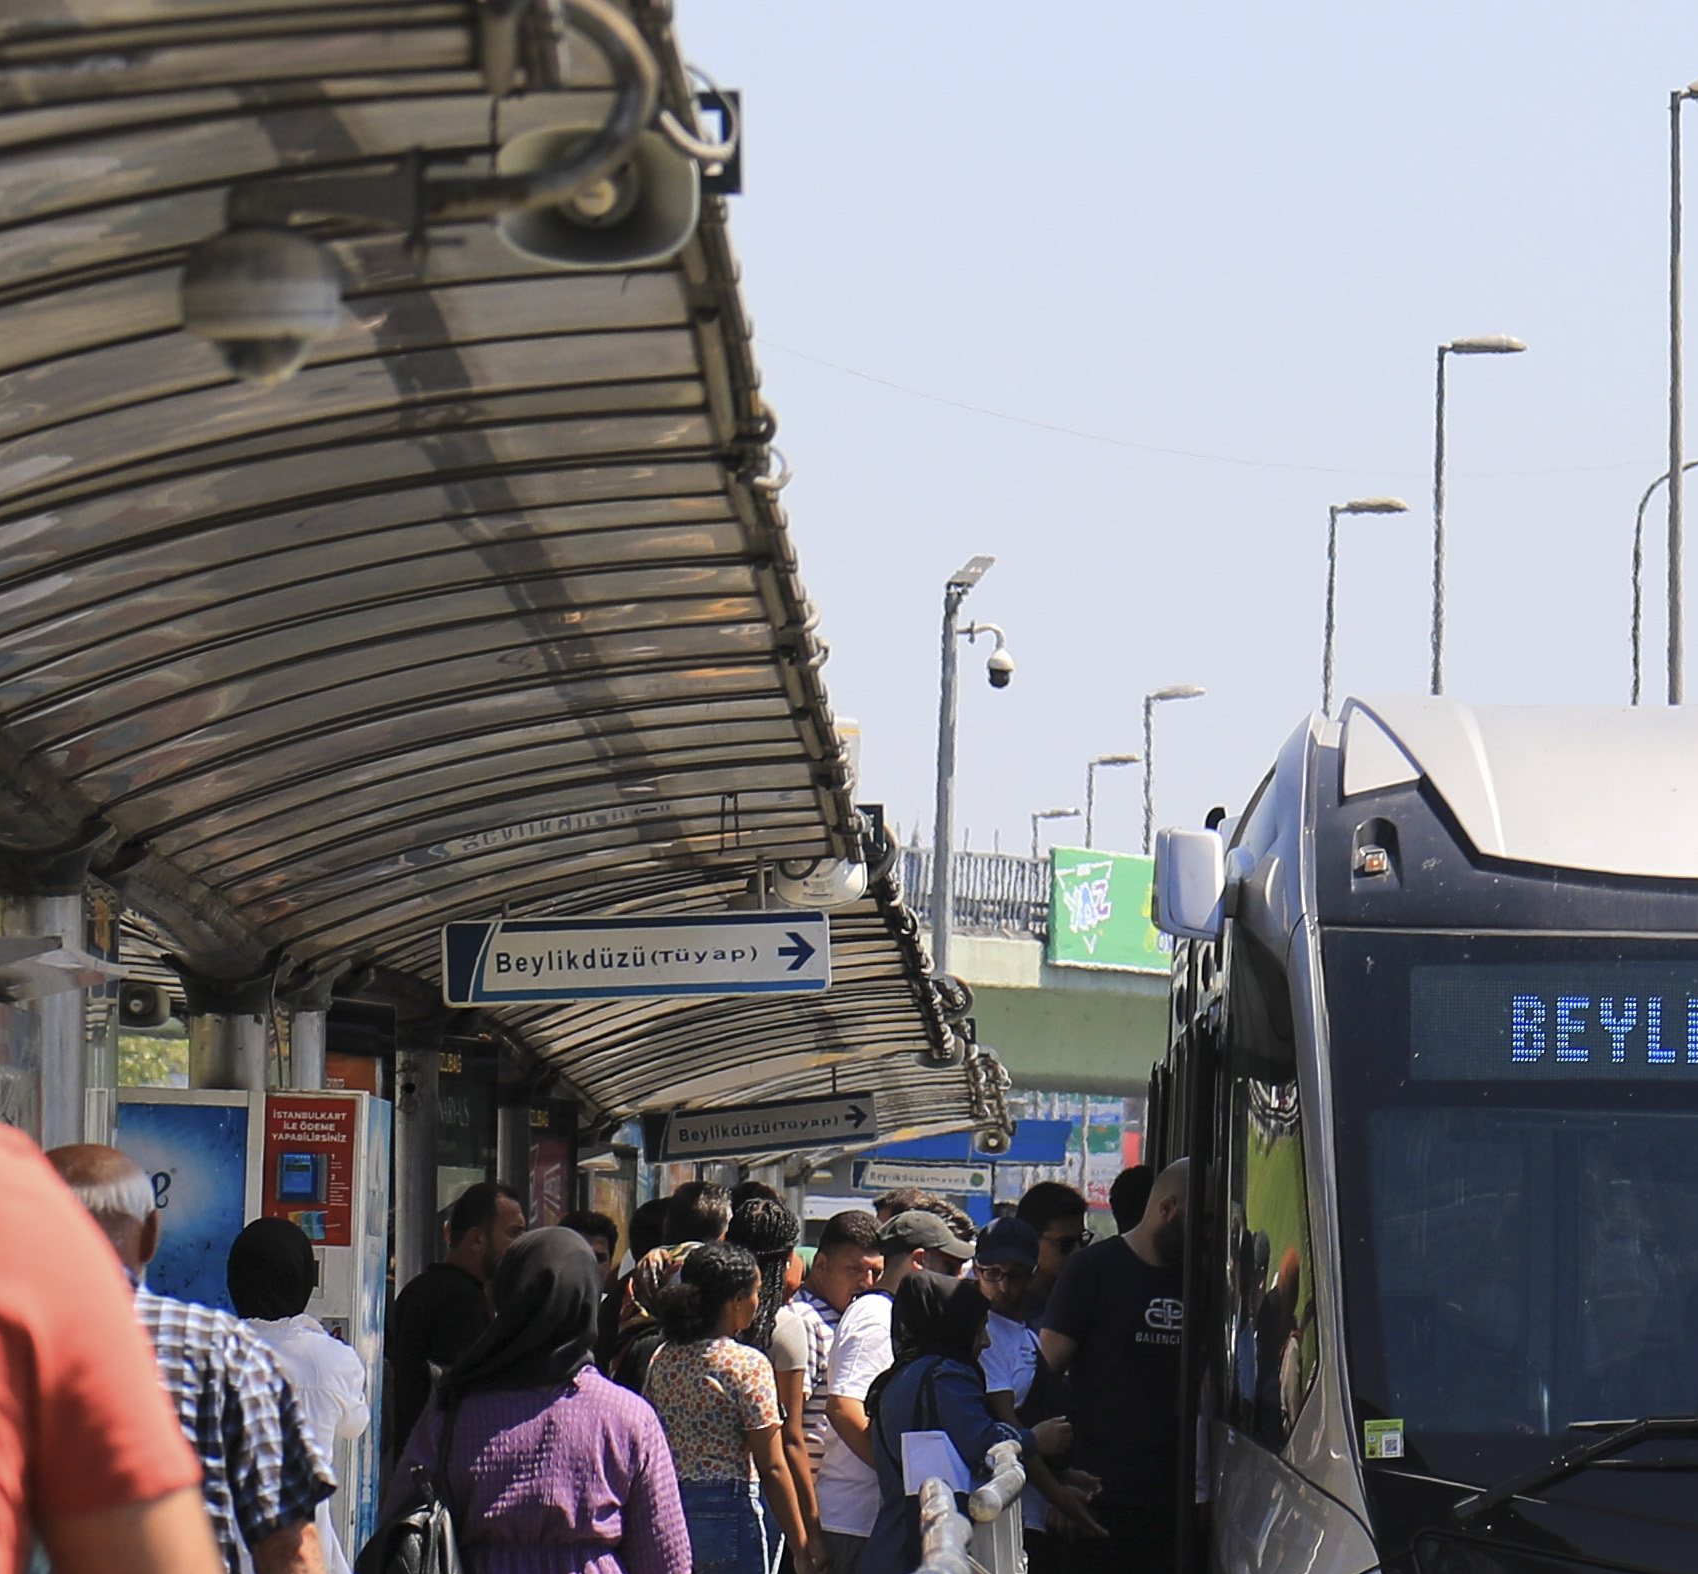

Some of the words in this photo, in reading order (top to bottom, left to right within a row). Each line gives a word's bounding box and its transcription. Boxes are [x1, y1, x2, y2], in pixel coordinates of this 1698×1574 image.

[273, 1109, 347, 1120] İSTANBULKART
[283, 1121, 297, 1130] İLE
[300, 1121, 335, 1131] ÖDEME
[1135, 1332, 1180, 1345] BALENCI
